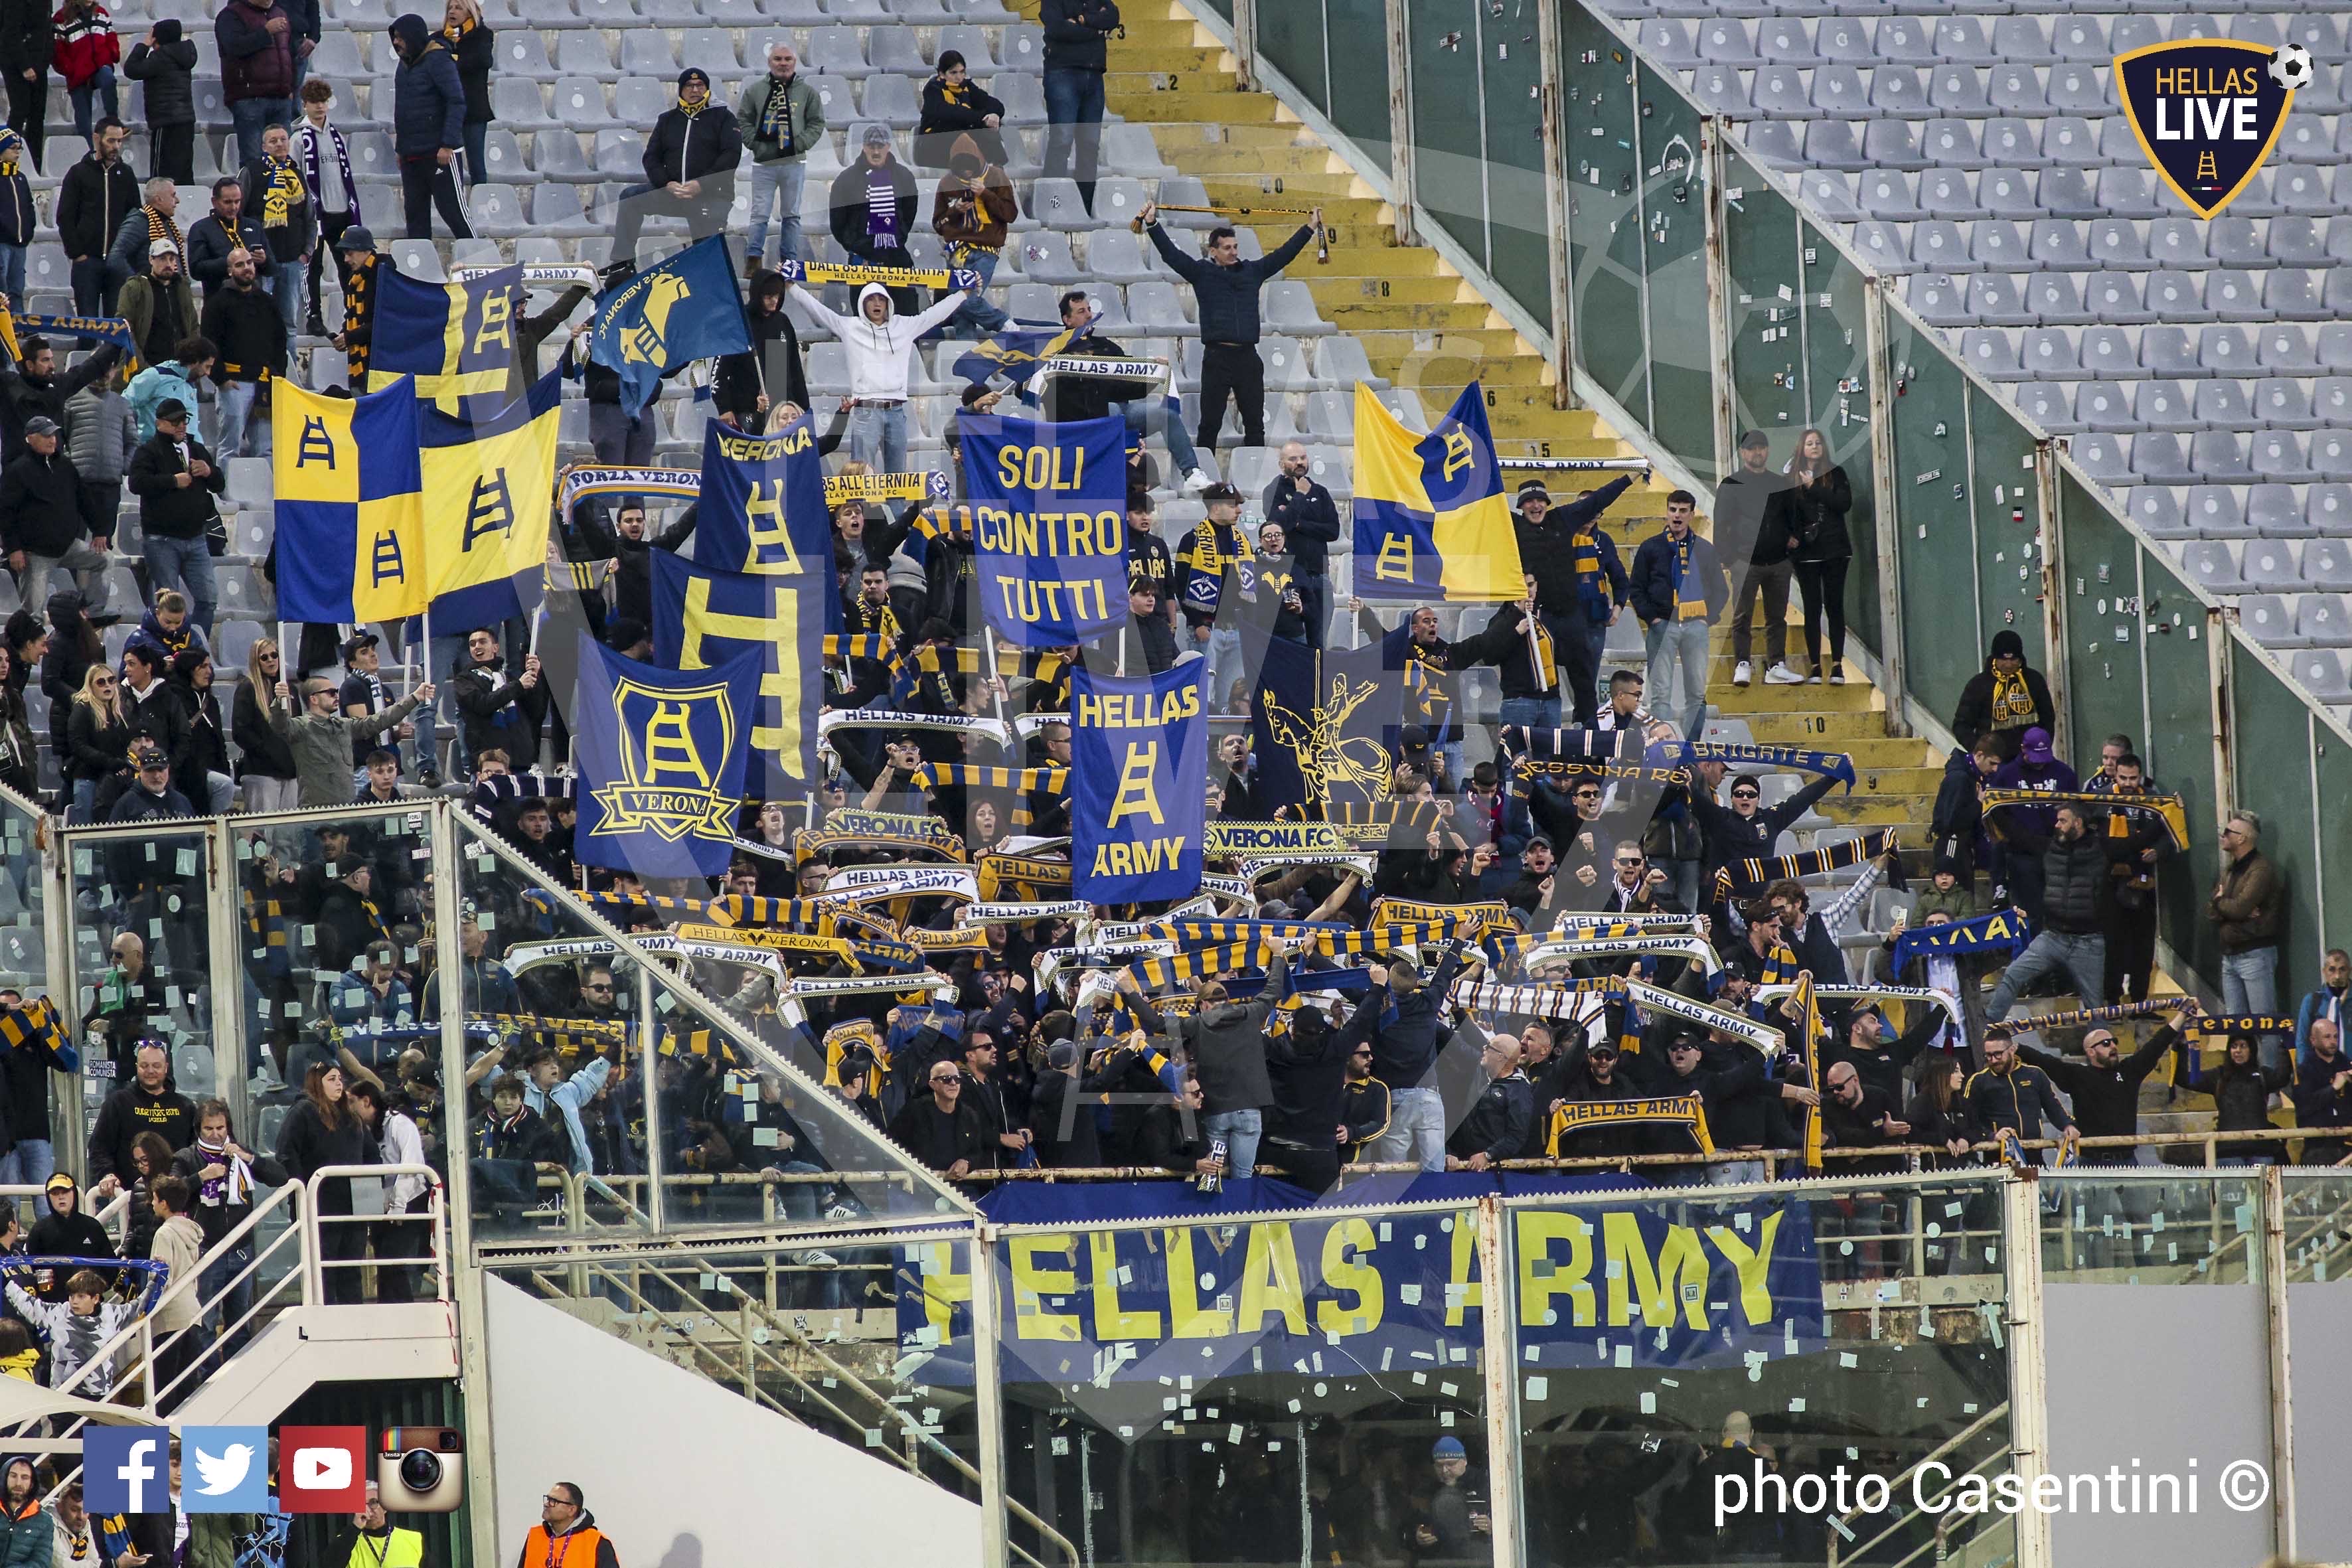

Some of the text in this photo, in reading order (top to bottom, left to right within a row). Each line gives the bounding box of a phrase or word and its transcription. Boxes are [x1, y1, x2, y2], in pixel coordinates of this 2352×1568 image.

[532, 269, 579, 279] ARMY
[52, 315, 128, 337] ARMY
[1046, 360, 1158, 375] HELLAS ARMY
[716, 426, 813, 462] VERONA
[998, 445, 1084, 491] SOLI
[570, 469, 702, 487] FORZA VERON
[977, 505, 1122, 558] CONTRO
[996, 575, 1109, 623] TUTTI
[1078, 684, 1200, 729] HELLAS
[844, 710, 977, 726] HELLAS ARMY
[1692, 742, 1812, 765] BRIGATE
[630, 793, 708, 815] VERONA
[1215, 828, 1304, 848] VERONA
[1090, 836, 1186, 878] ARMY
[987, 860, 1061, 880] HELLAS
[1240, 858, 1304, 878] HELLAS
[846, 870, 909, 886] HELLAS
[899, 874, 966, 892] ARMY
[971, 901, 1088, 918] HELLAS ARMY
[1387, 905, 1456, 921] HELLAS
[1563, 914, 1696, 931] HELLAS ARMY
[542, 937, 676, 956] HELLAS RMY
[692, 927, 830, 949] HELLAS VERONA
[1553, 938, 1695, 954] HELLAS ARMY
[684, 945, 772, 965] LAS ARMY
[856, 942, 918, 963] ARM
[1049, 945, 1115, 961] HELLAS
[1575, 977, 1626, 993] ARM
[1877, 984, 1932, 995] ARMY
[1643, 990, 1757, 1037] HELLAS ARMY
[2203, 1016, 2294, 1032] erona
[90, 1060, 116, 1069] ROMANISTA
[90, 1068, 116, 1077] COMUNISTA
[1562, 1103, 1638, 1123] HELLAS
